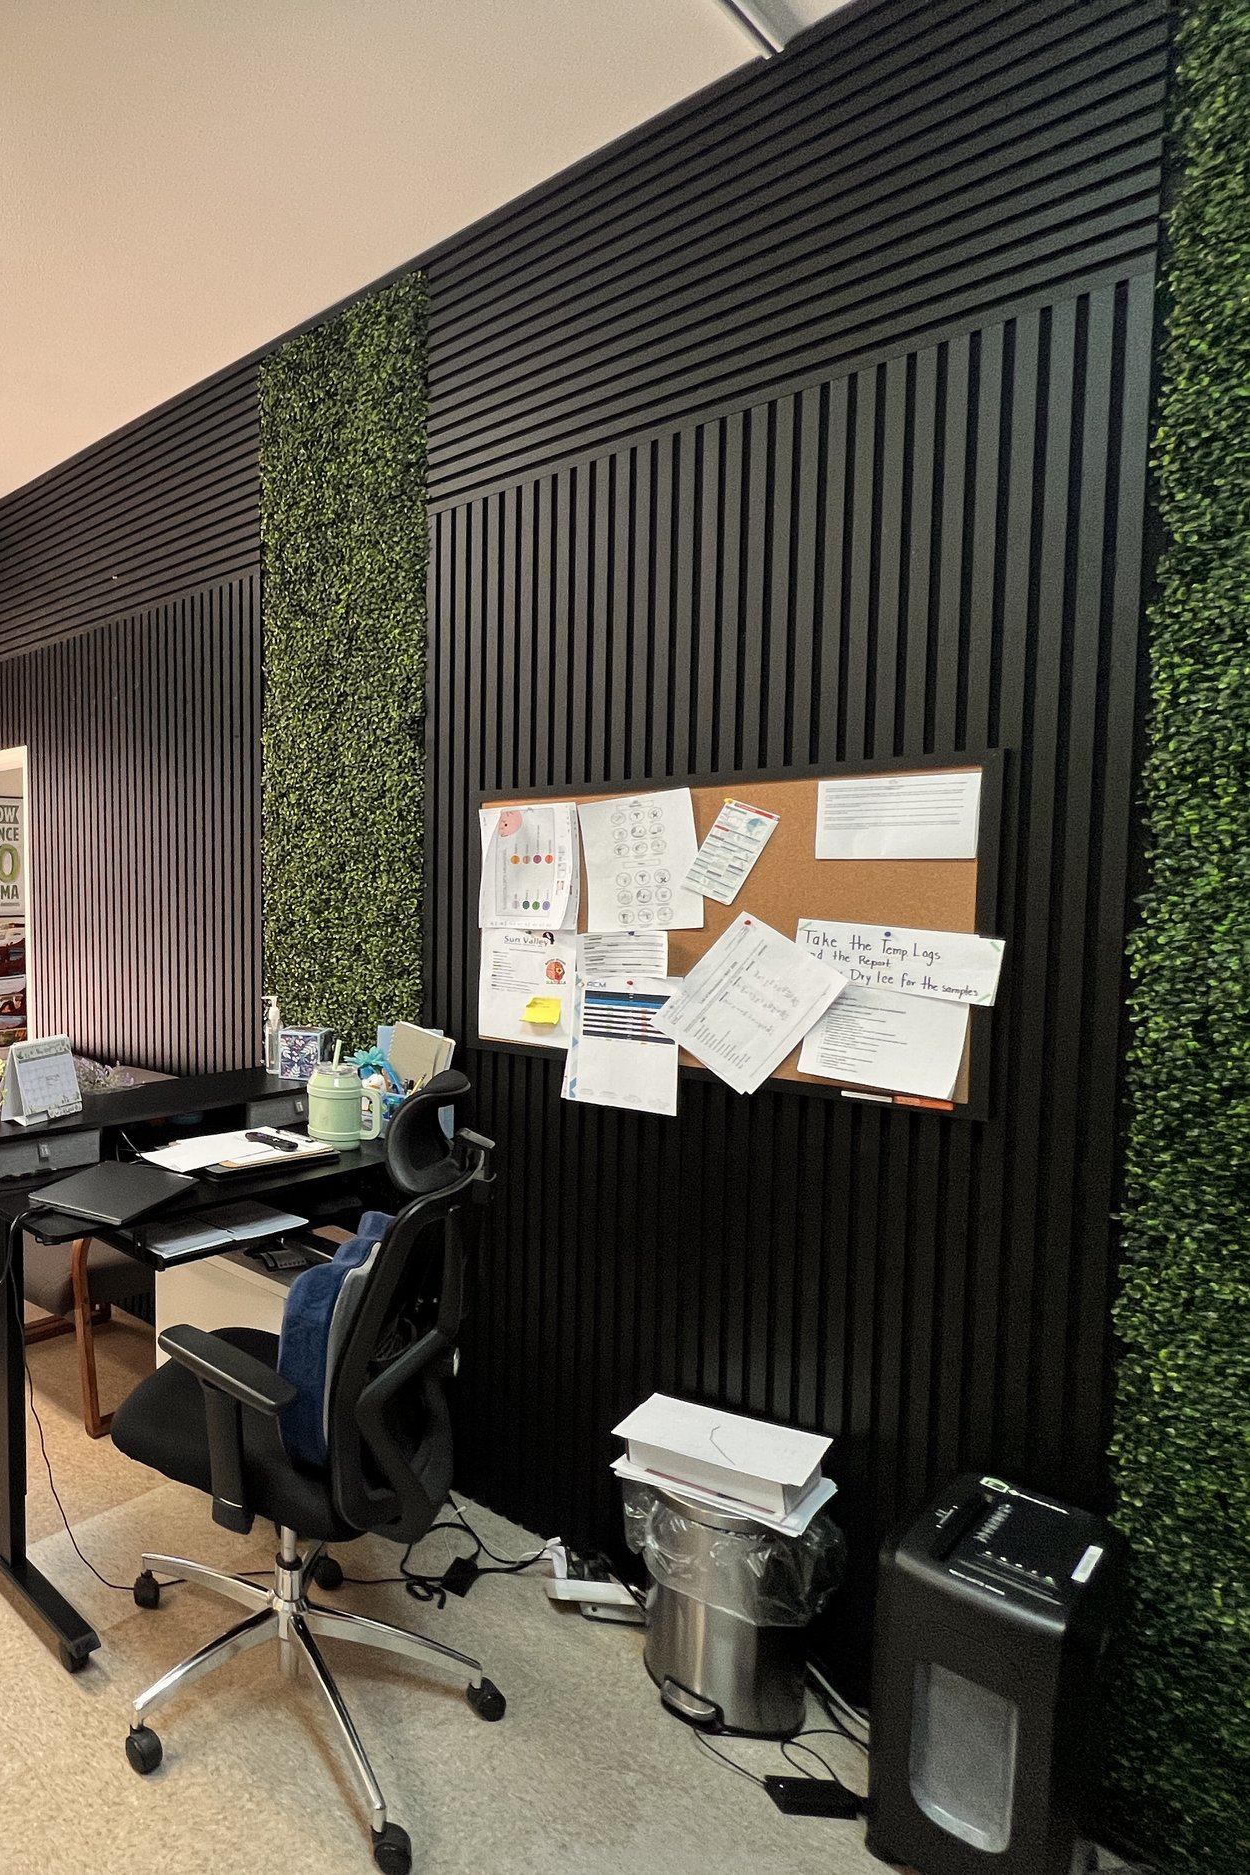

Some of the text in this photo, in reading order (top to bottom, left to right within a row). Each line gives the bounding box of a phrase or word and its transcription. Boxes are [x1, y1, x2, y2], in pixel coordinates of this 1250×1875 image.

[522, 936, 548, 946] Valley
[804, 929, 838, 948] Take
[849, 934, 872, 952] the
[833, 951, 850, 963] the
[850, 969, 871, 985] Dry
[900, 972, 916, 988] for
[921, 976, 938, 992] the
[942, 984, 978, 1000] samples
